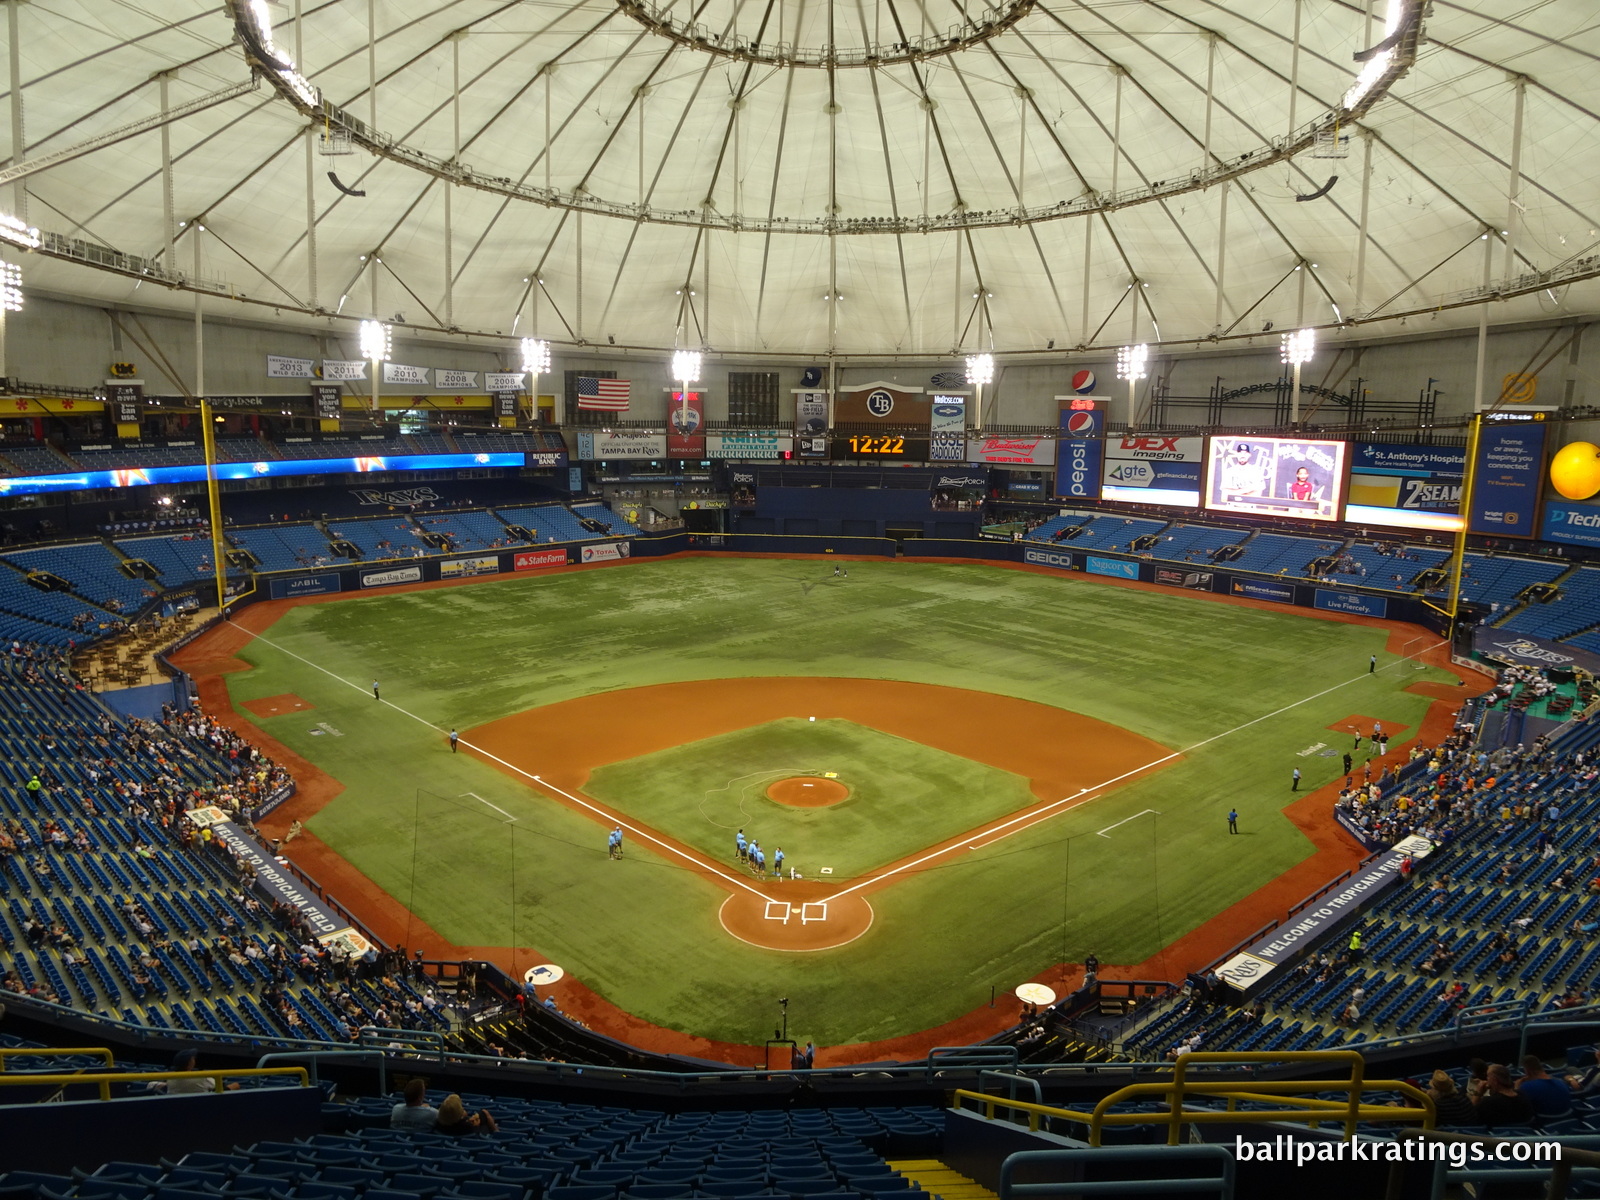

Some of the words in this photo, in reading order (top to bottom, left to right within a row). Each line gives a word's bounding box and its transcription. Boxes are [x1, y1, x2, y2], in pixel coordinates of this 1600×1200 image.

[279, 363, 303, 372] 2013
[393, 370, 417, 379] 2010
[445, 375, 467, 383] 2008
[581, 440, 591, 448] 12
[849, 435, 904, 453] 12:22
[931, 431, 963, 447] ROSE
[987, 440, 1036, 449] Budweiser
[1120, 435, 1181, 452] DEX
[1500, 437, 1523, 446] home
[931, 446, 963, 460] RADIOLOGY
[1132, 449, 1185, 461] imaging
[1375, 451, 1387, 460] St.
[1388, 452, 1429, 464] Anthony's
[1430, 454, 1467, 465] Hospital
[1486, 453, 1518, 463] keeping
[1518, 455, 1533, 463] you
[1070, 443, 1089, 497] pepsi
[1124, 465, 1147, 478] gte
[1487, 463, 1530, 471] connected.
[1484, 510, 1504, 518] bright
[1567, 511, 1600, 529] Tech
[1026, 550, 1071, 566] GEICO
[1091, 558, 1121, 571] Sagicor
[365, 576, 388, 585] Tampa
[388, 574, 400, 583] Bay
[400, 572, 418, 580] Times
[1158, 570, 1182, 581] GMC
[291, 579, 321, 588] JABIL
[1328, 600, 1342, 608] Live
[1342, 602, 1371, 613] Fiercely.
[213, 823, 252, 856] WELCOME
[249, 855, 263, 866] TO
[257, 864, 309, 907] TROPICANA
[302, 904, 336, 933] FIELD
[1258, 918, 1319, 959] WELCOME
[1314, 907, 1333, 924] TO
[1326, 868, 1386, 910] TROPICANA
